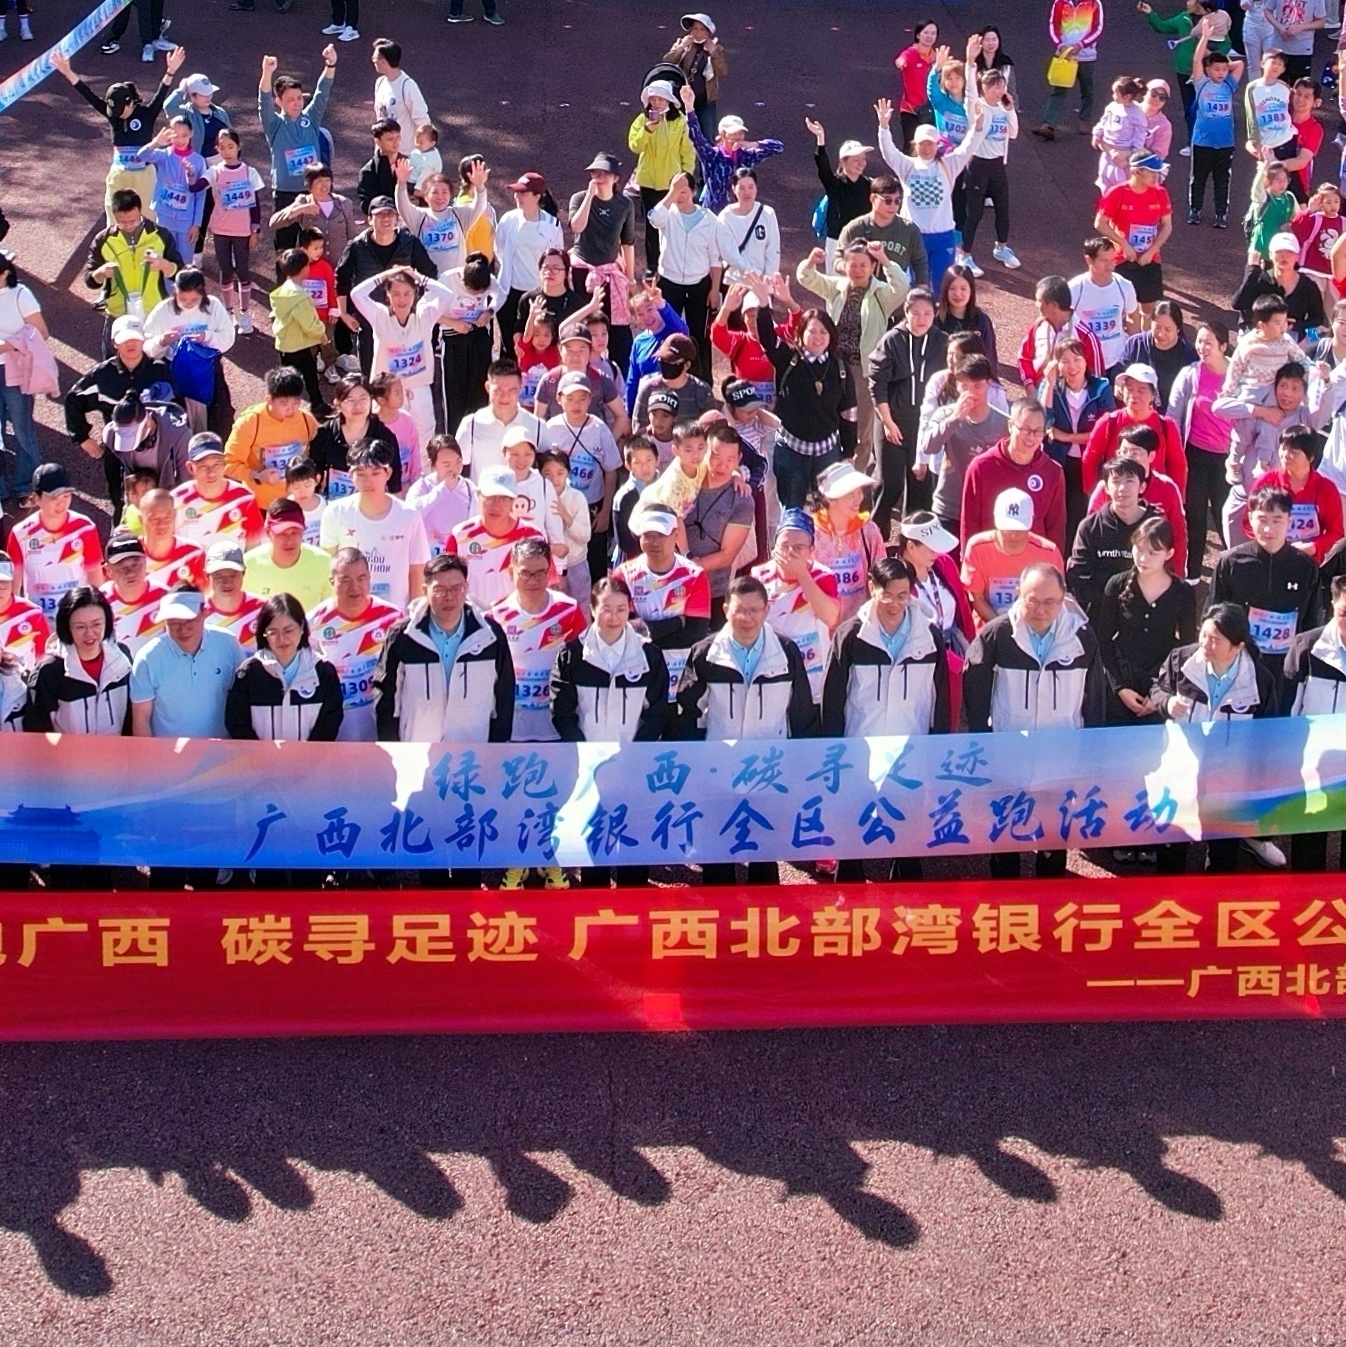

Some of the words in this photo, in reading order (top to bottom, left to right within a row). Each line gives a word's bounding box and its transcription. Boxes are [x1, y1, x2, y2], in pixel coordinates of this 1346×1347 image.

[1261, 113, 1285, 124] 1383
[945, 121, 966, 134] 1302
[290, 156, 314, 167] 1447
[163, 192, 186, 204] 1448
[225, 192, 250, 201] 1449
[428, 232, 454, 242] 1370
[393, 355, 421, 369] 1324
[1254, 624, 1290, 640] 1428
[515, 684, 549, 698] 1326
[242, 784, 1182, 863] 广西北部湾银行全区公益跑活动
[221, 910, 540, 966] 碳寻足迹
